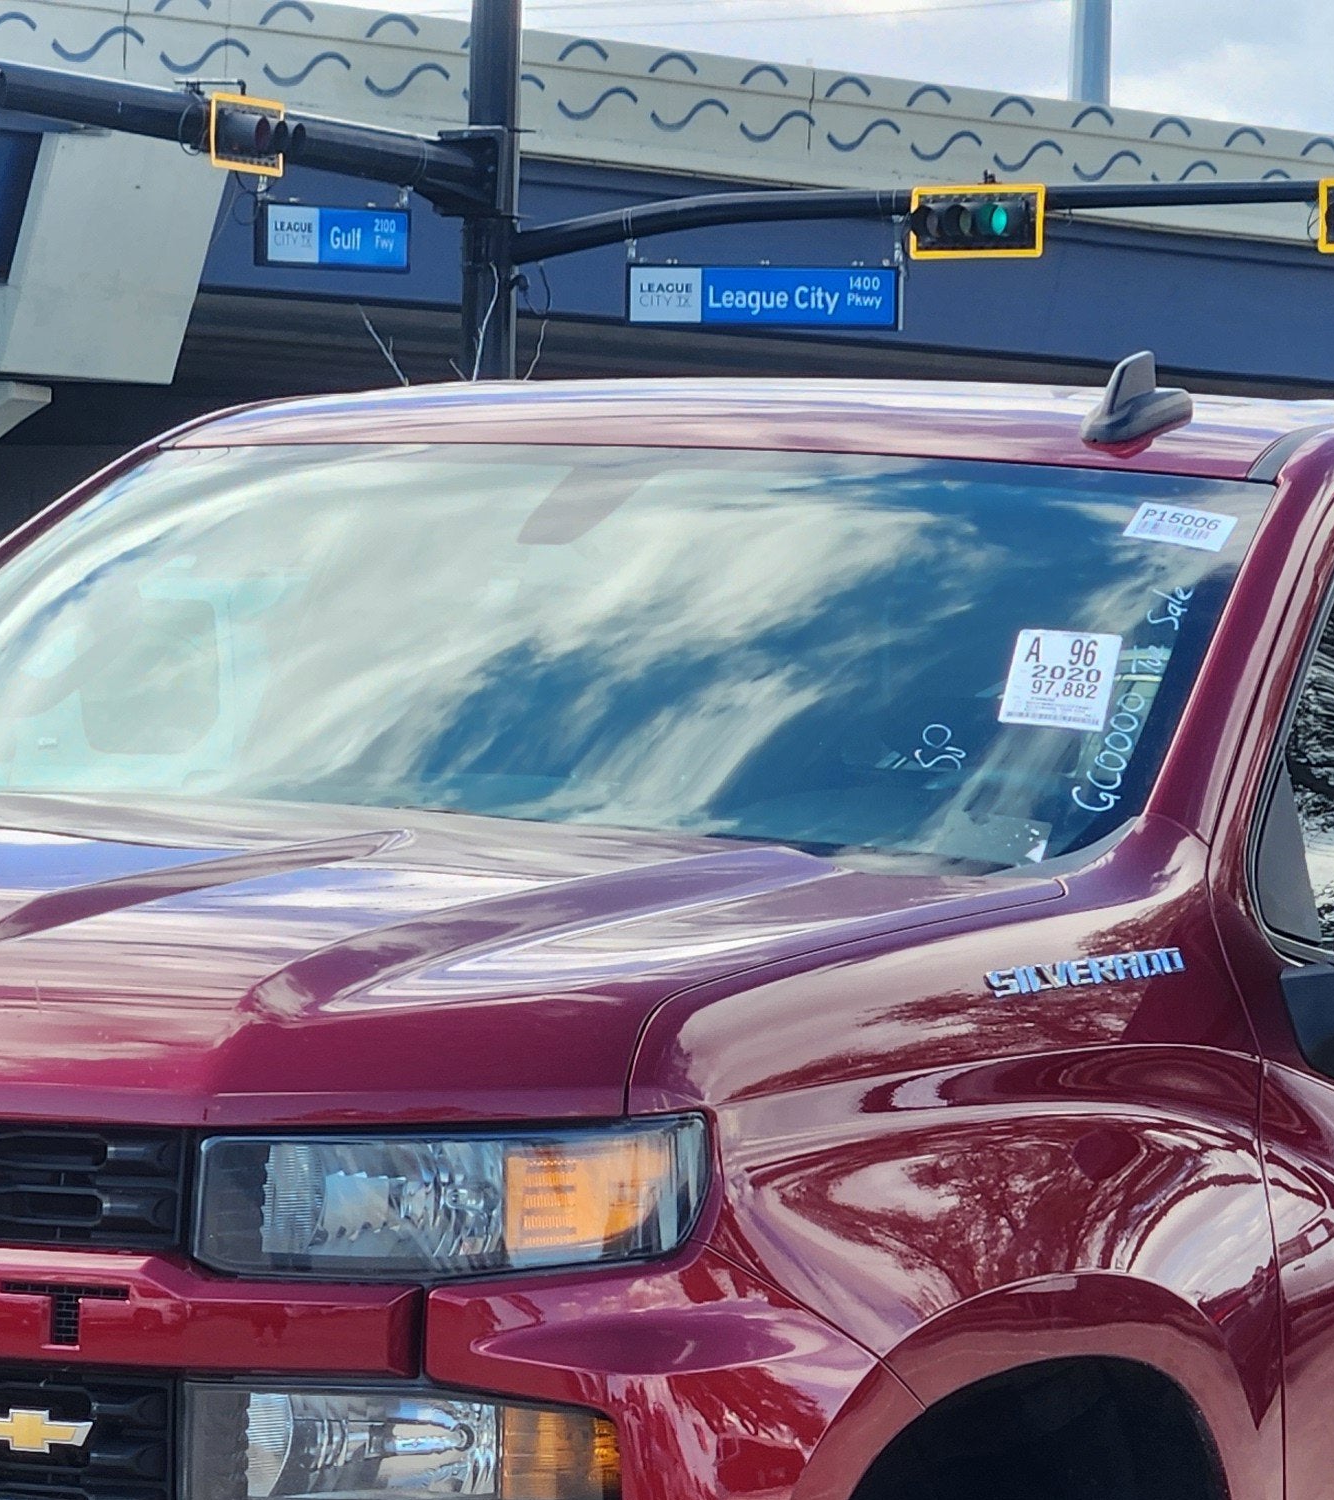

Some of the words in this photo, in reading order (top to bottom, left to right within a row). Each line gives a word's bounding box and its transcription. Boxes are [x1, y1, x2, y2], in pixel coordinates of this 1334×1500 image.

[274, 220, 313, 234] LEAGUE
[373, 217, 397, 234] 2100
[273, 232, 298, 247] CITY
[329, 225, 363, 251] Gulf
[374, 235, 395, 253] Fwy
[639, 281, 693, 294] LEAGUE
[849, 276, 881, 292] 1400
[639, 294, 671, 308] CITY
[708, 284, 789, 316] League
[794, 285, 840, 316] City
[846, 294, 883, 310] Pkwy
[1141, 508, 1222, 531] P15006
[1147, 586, 1195, 631] Sale
[1024, 636, 1042, 663] A
[1068, 638, 1098, 667] 96
[1031, 664, 1102, 684] 2020
[1030, 679, 1098, 699] 97,882
[983, 946, 1186, 998] SILVERADO
